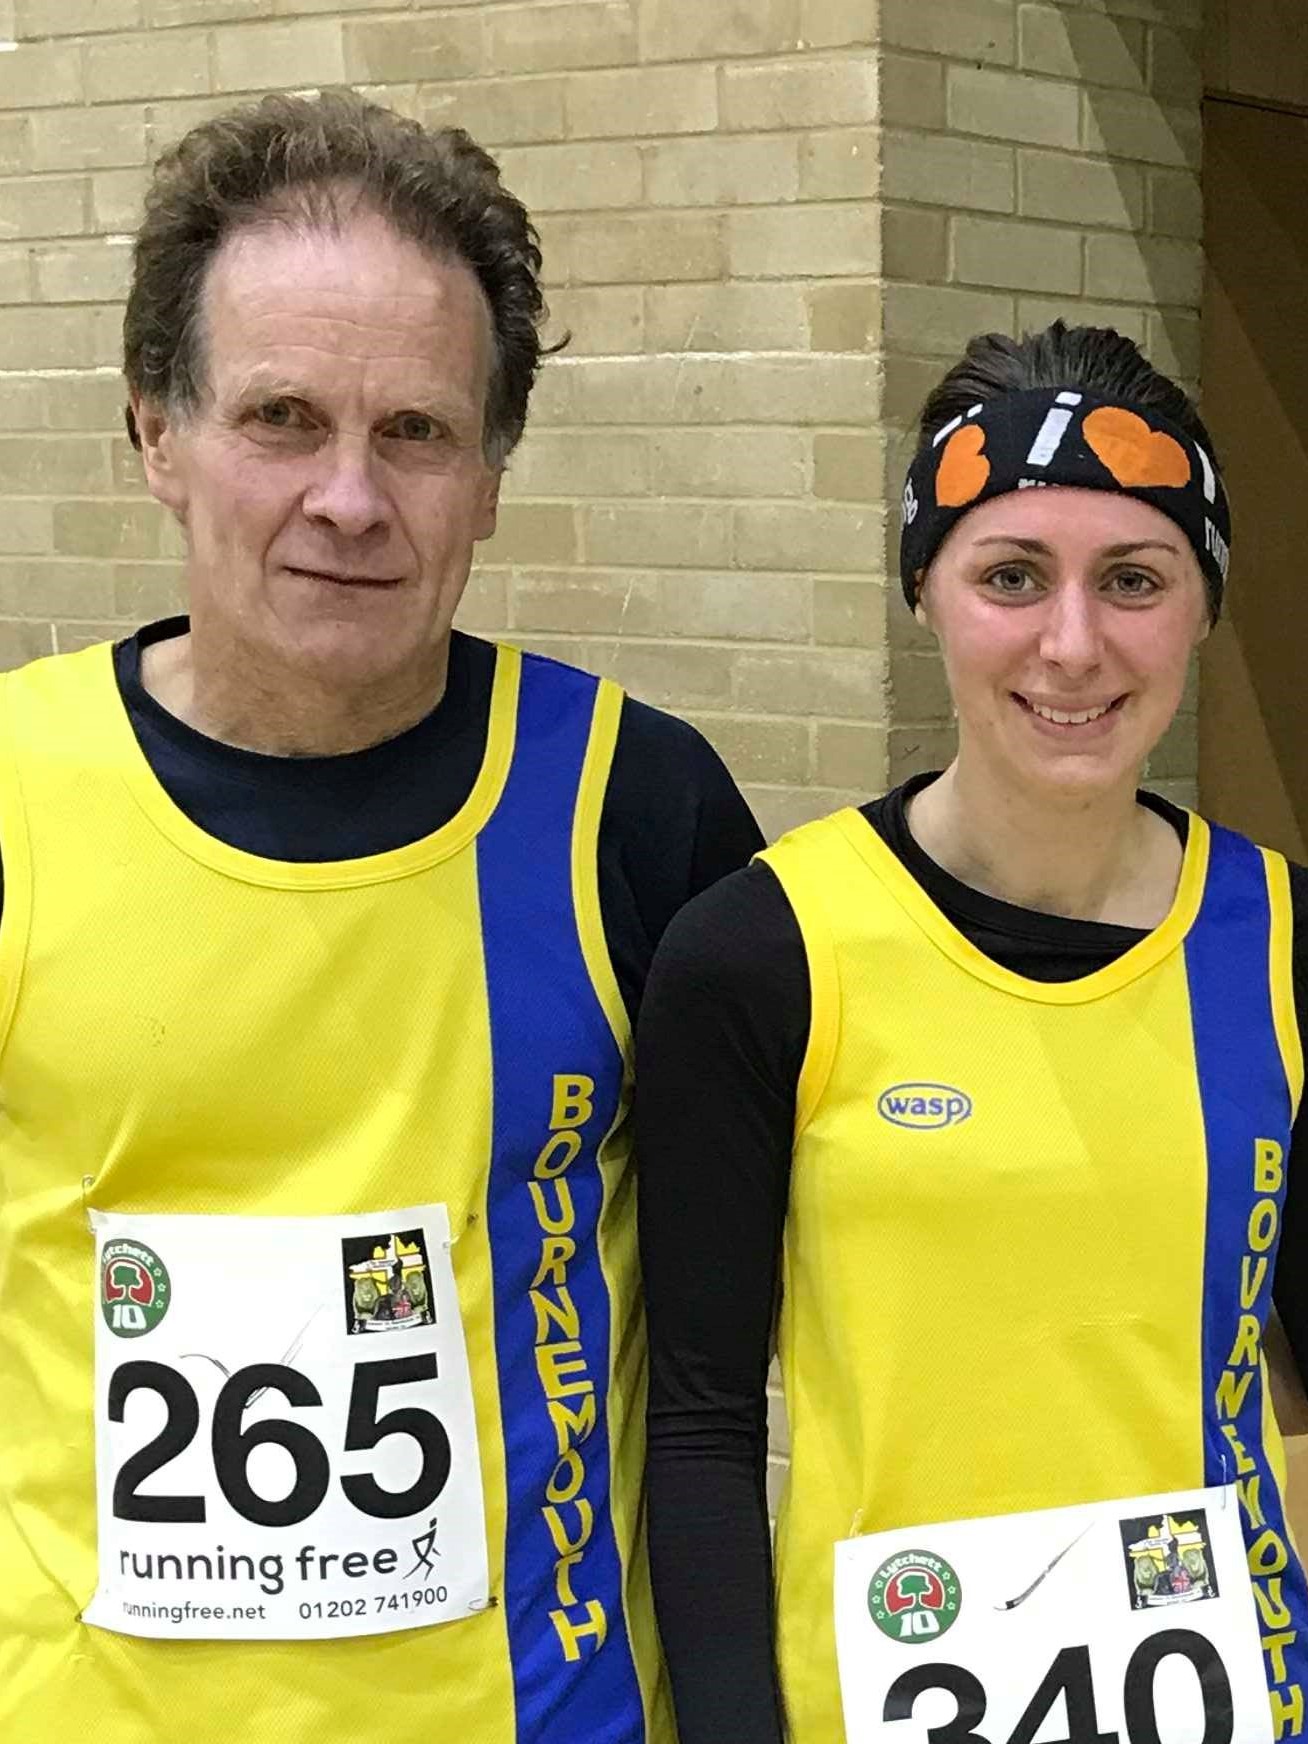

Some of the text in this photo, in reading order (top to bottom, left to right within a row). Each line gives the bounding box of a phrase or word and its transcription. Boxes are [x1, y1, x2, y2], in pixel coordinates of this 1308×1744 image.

[886, 1096, 964, 1124] wasp
[112, 1304, 147, 1330] 10
[527, 1073, 606, 1662] BOURNEMOUTH
[108, 1352, 452, 1527] 265
[120, 1545, 398, 1595] running free
[879, 1553, 943, 1578] Lytchett
[122, 1586, 448, 1624] runningfree.net 01202 741900
[899, 1610, 940, 1637] 10
